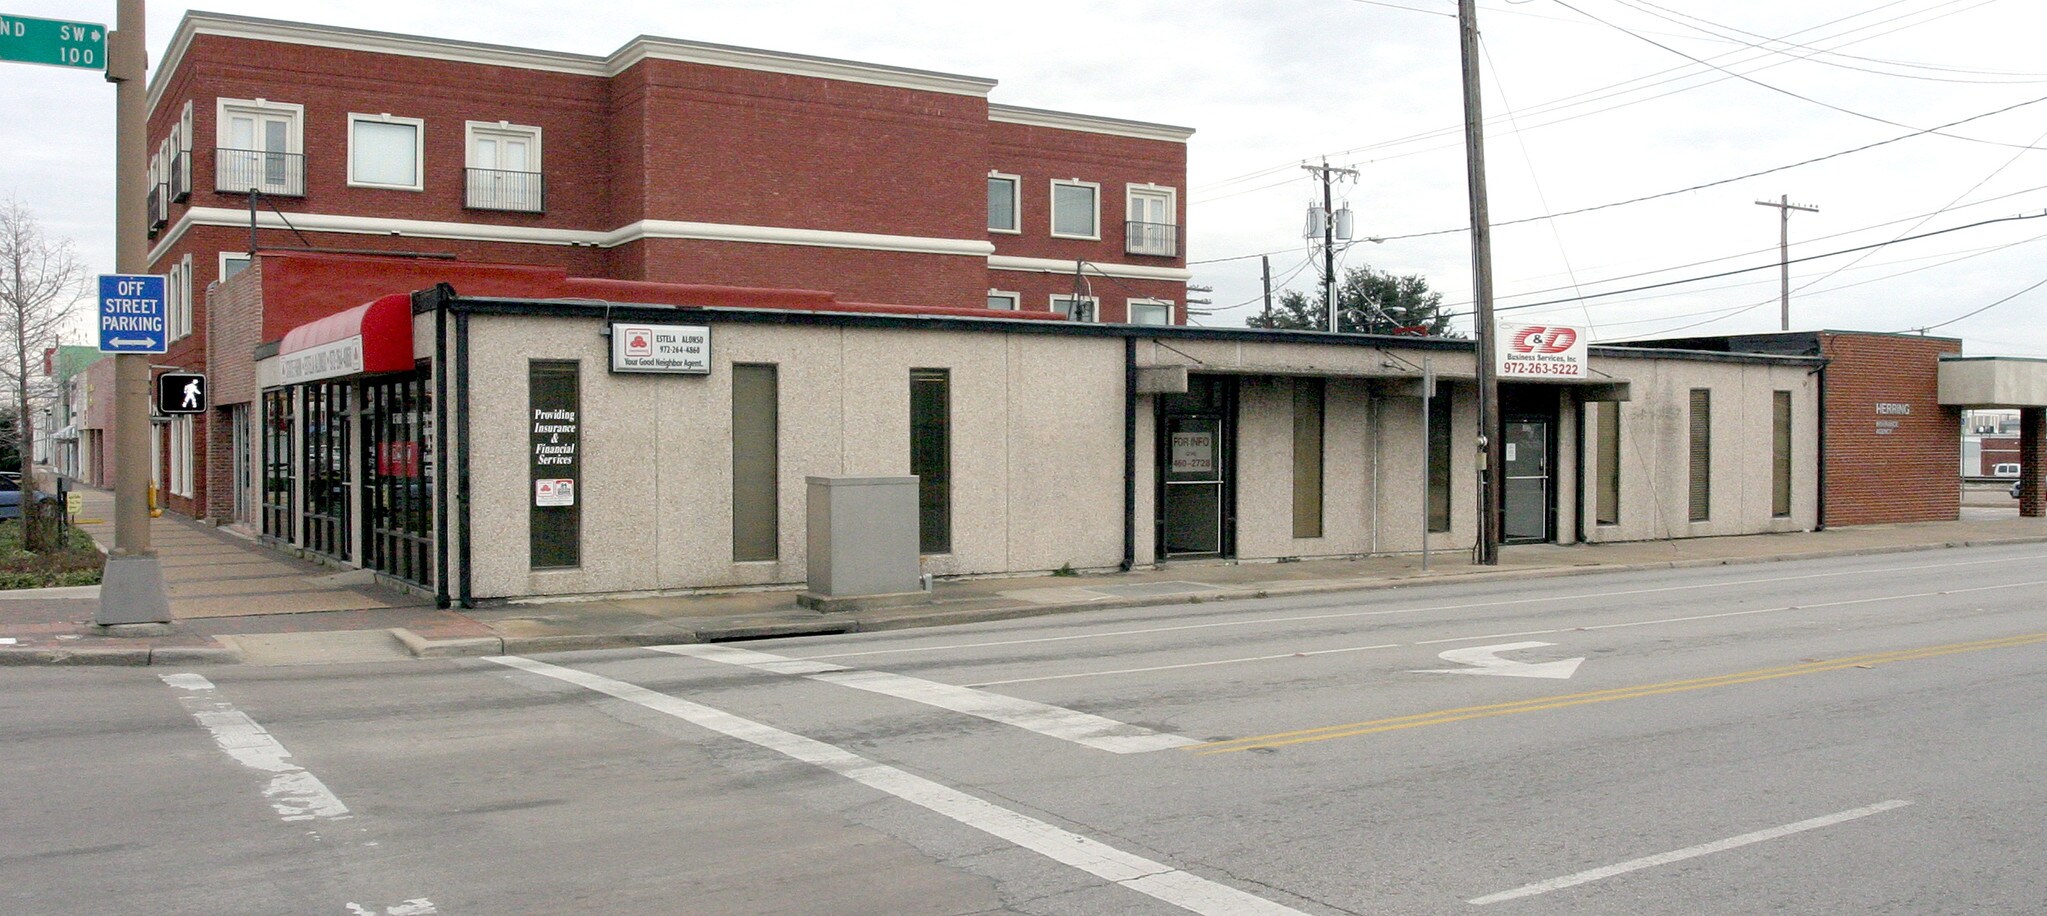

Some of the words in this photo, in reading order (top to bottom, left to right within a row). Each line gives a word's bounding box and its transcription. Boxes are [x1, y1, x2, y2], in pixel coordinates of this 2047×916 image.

[60, 25, 85, 42] SW
[60, 47, 94, 64] 100
[118, 281, 145, 296] OFF
[105, 298, 158, 314] STREET
[102, 316, 162, 331] PARKING
[656, 335, 676, 343] ESTELA
[682, 336, 704, 344] ALONSO
[1508, 326, 1577, 353] C&D
[624, 358, 638, 366] Your
[639, 358, 654, 366] Good
[656, 358, 683, 368] Neighbor
[684, 360, 704, 369] Agent.
[1507, 353, 1535, 361] Business
[1537, 354, 1566, 362] Services,
[1504, 362, 1578, 375] 972-263-5222
[1876, 403, 1910, 415] HERRING
[535, 409, 575, 422] Providing
[534, 422, 576, 433] Insurance
[550, 433, 559, 444] &
[1173, 437, 1189, 446] FOR
[536, 443, 575, 454] Financial
[538, 454, 572, 465] Services
